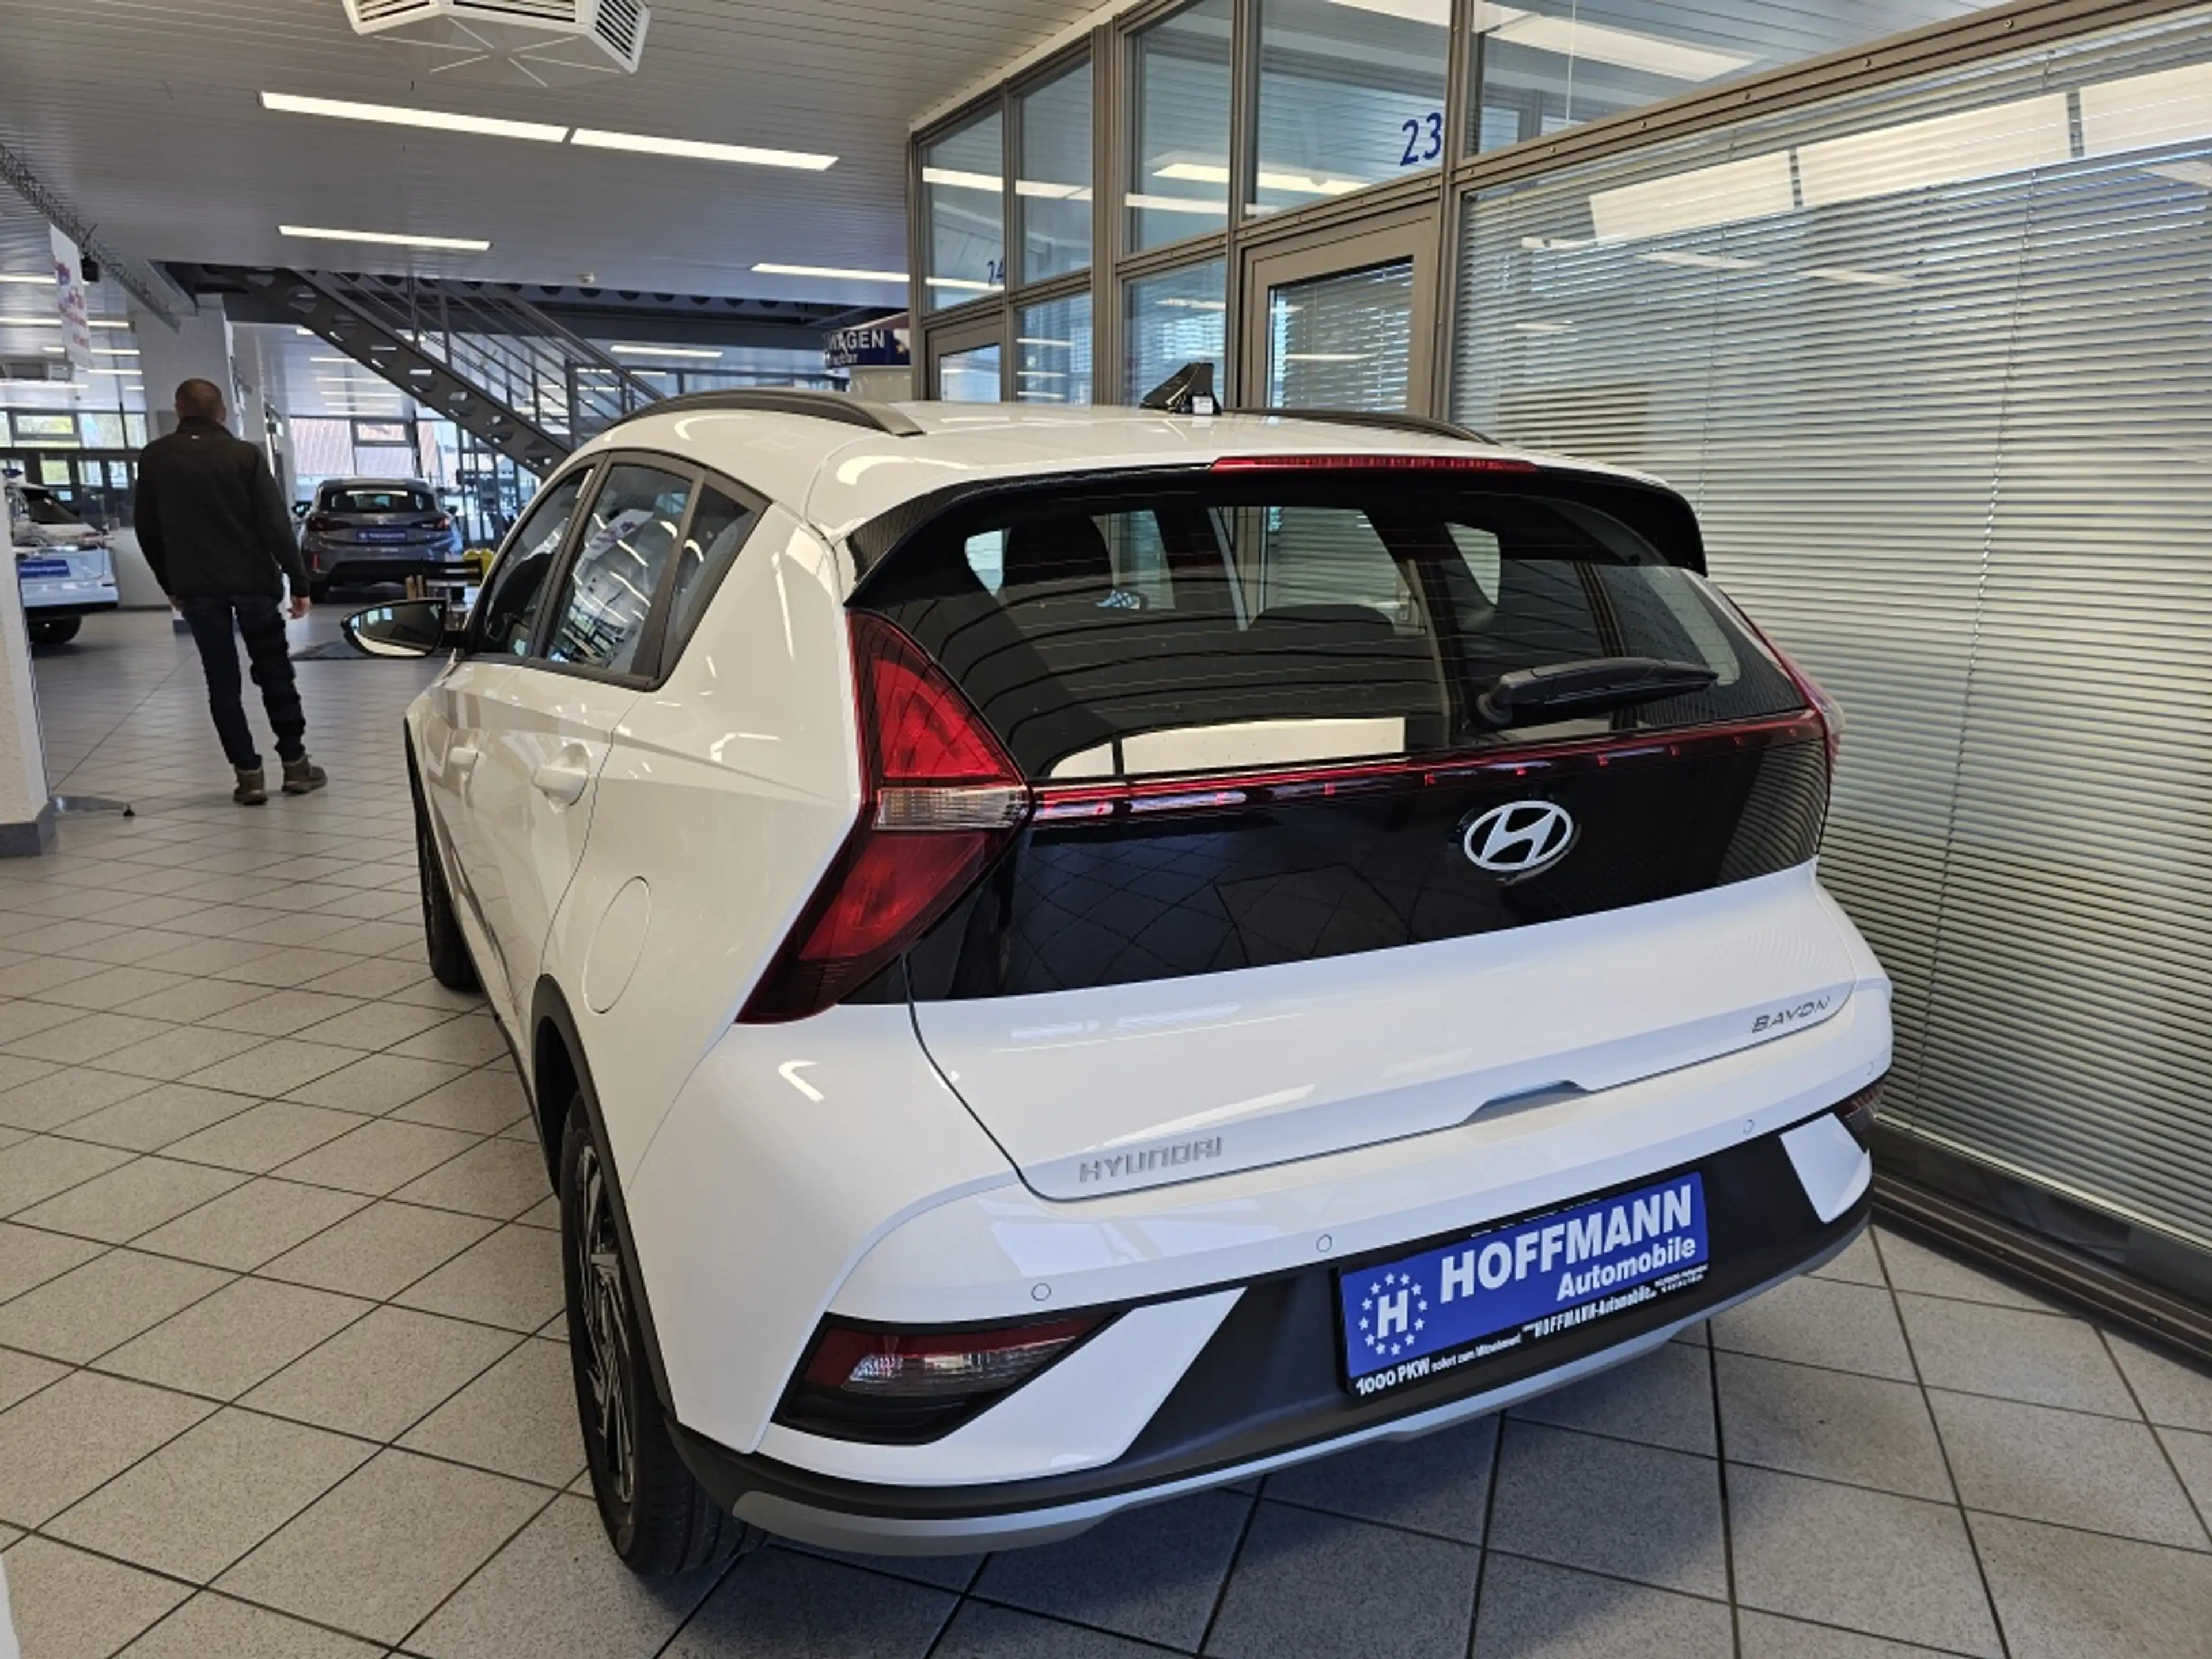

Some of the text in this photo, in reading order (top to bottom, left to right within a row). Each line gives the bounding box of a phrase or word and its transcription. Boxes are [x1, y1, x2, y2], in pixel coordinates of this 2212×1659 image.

[1400, 112, 1442, 166] 23
[1079, 1135, 1222, 1183] HYUNDAI
[1440, 1184, 1692, 1304] HOFFMANN
[1556, 1236, 1696, 1302] Automobile
[1378, 1289, 1409, 1339] H
[1355, 1370, 1396, 1396] 1000
[1397, 1357, 1430, 1383] PKW
